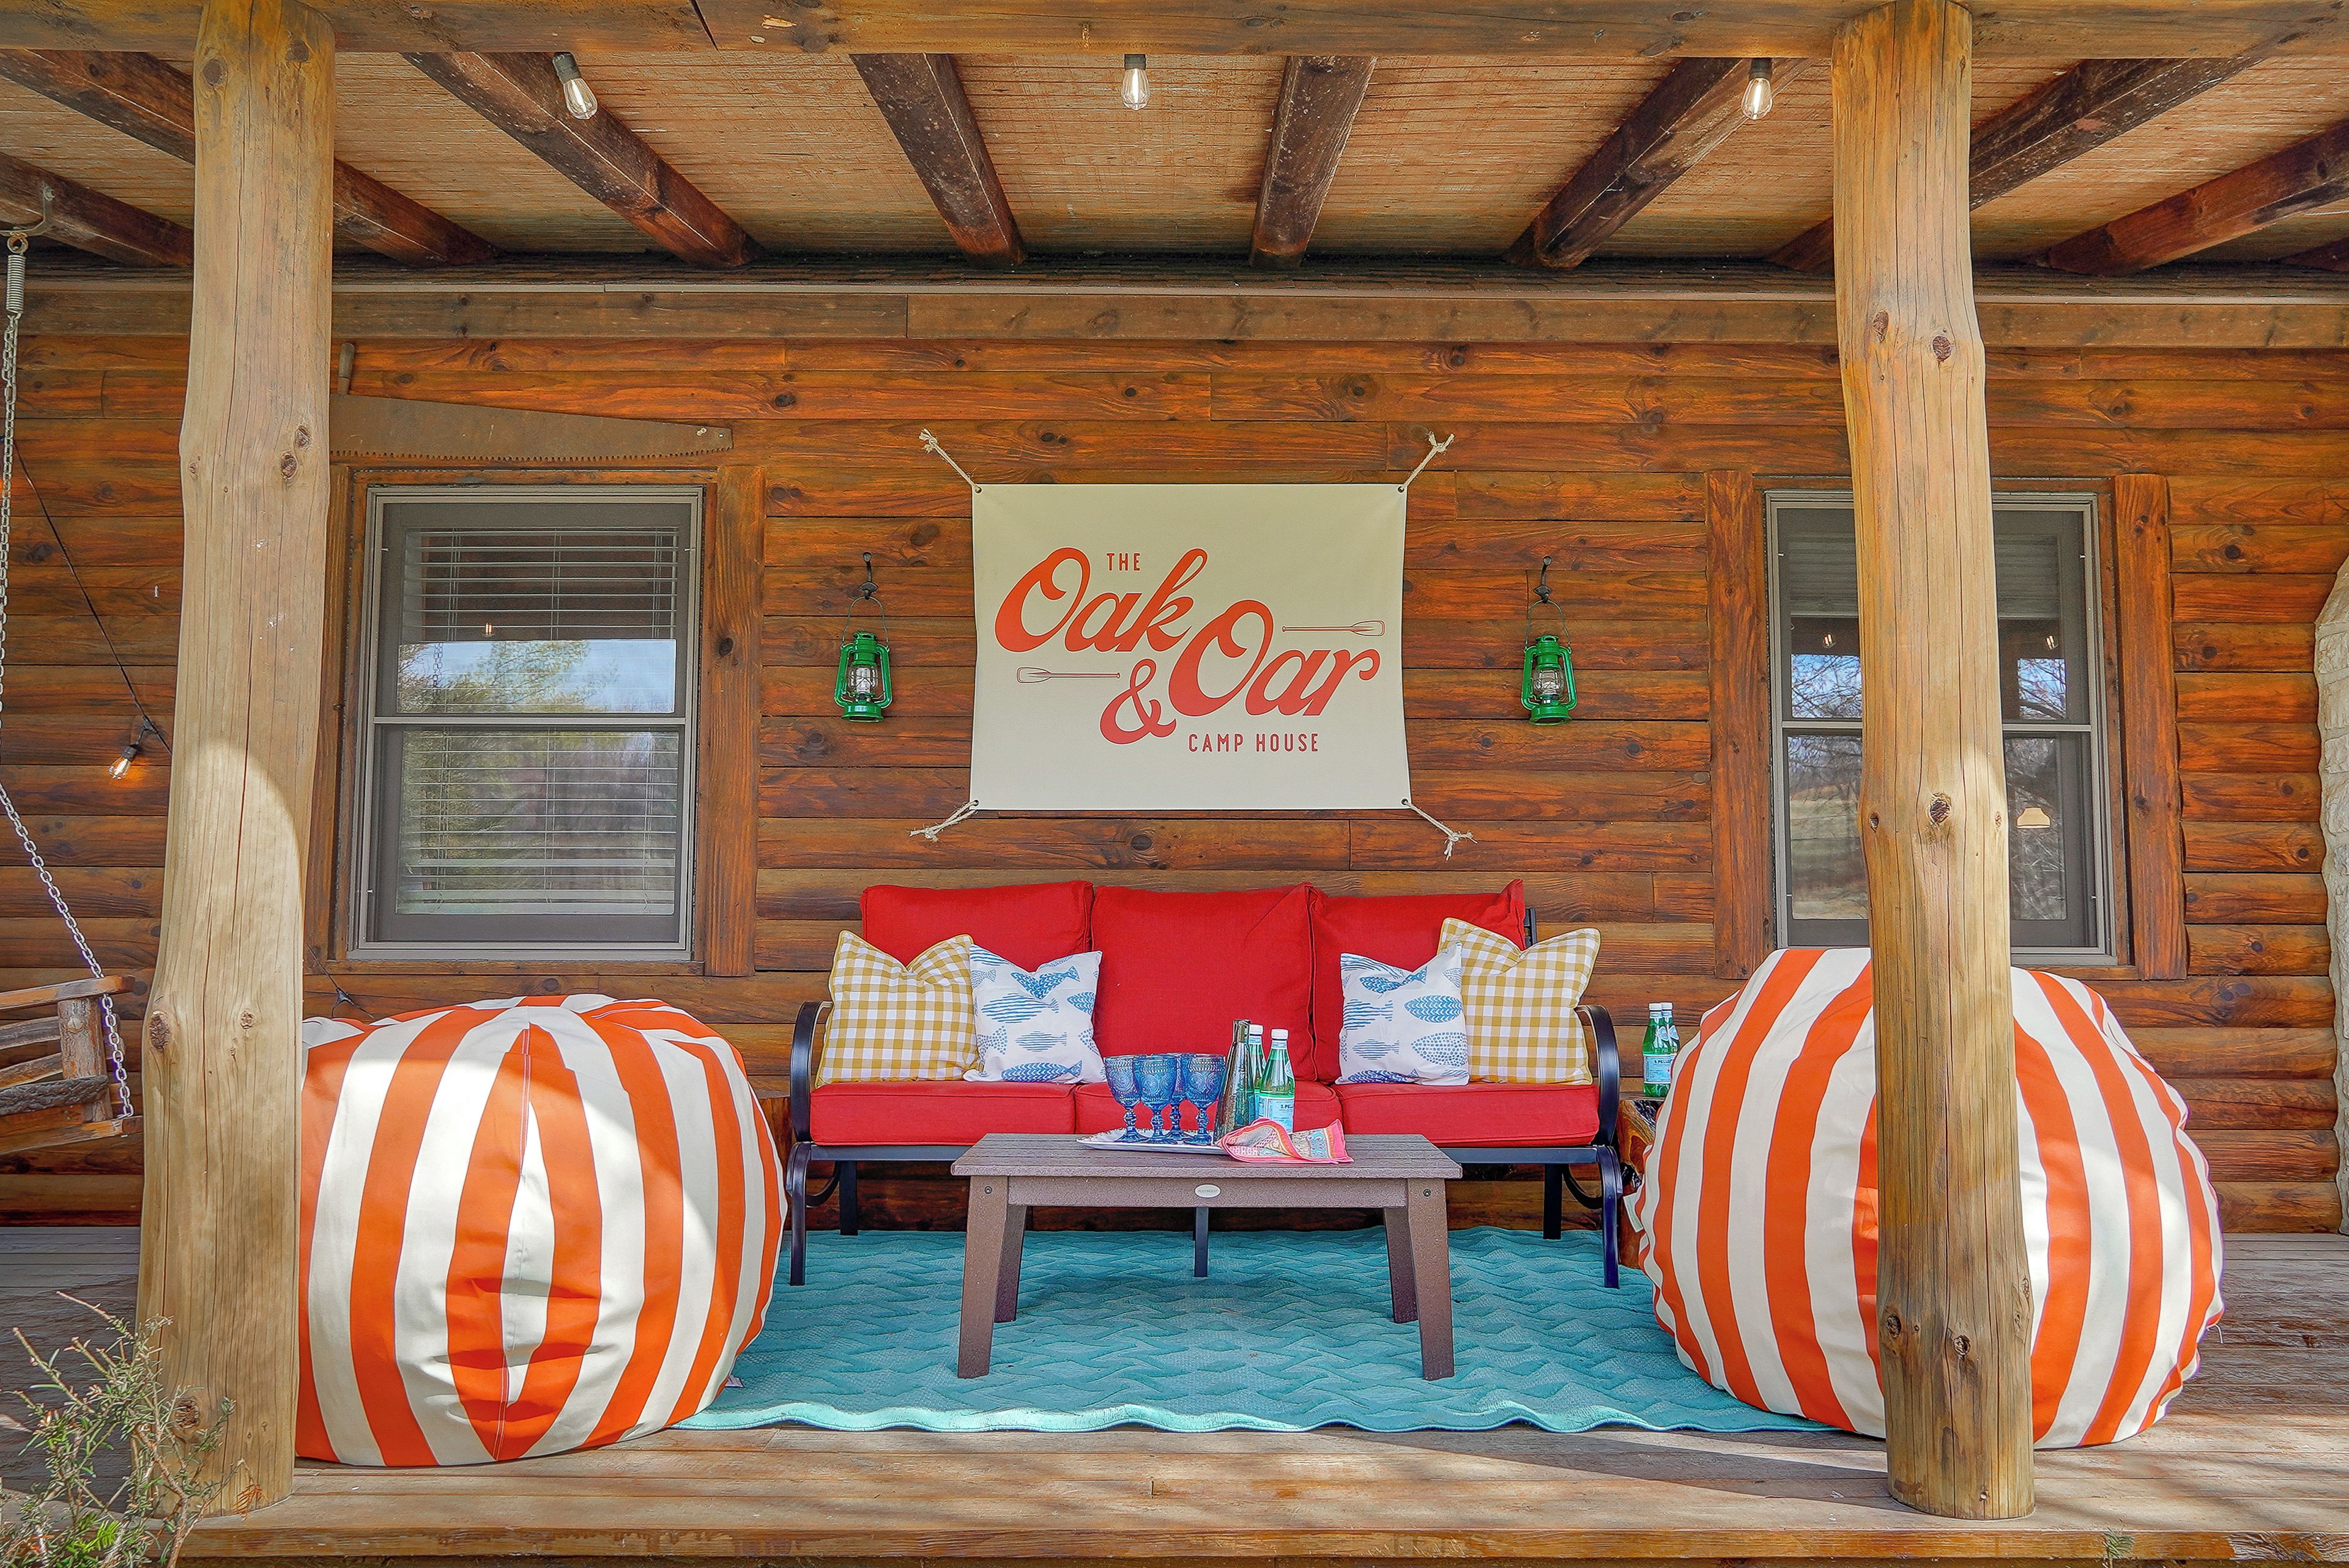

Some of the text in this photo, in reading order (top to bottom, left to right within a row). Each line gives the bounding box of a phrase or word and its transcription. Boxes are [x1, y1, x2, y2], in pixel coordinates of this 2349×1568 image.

[1106, 552, 1141, 571] THE
[993, 546, 1209, 653] Oak
[1099, 599, 1381, 745] & Oar
[1187, 733, 1318, 752] CAMP HOUSE
